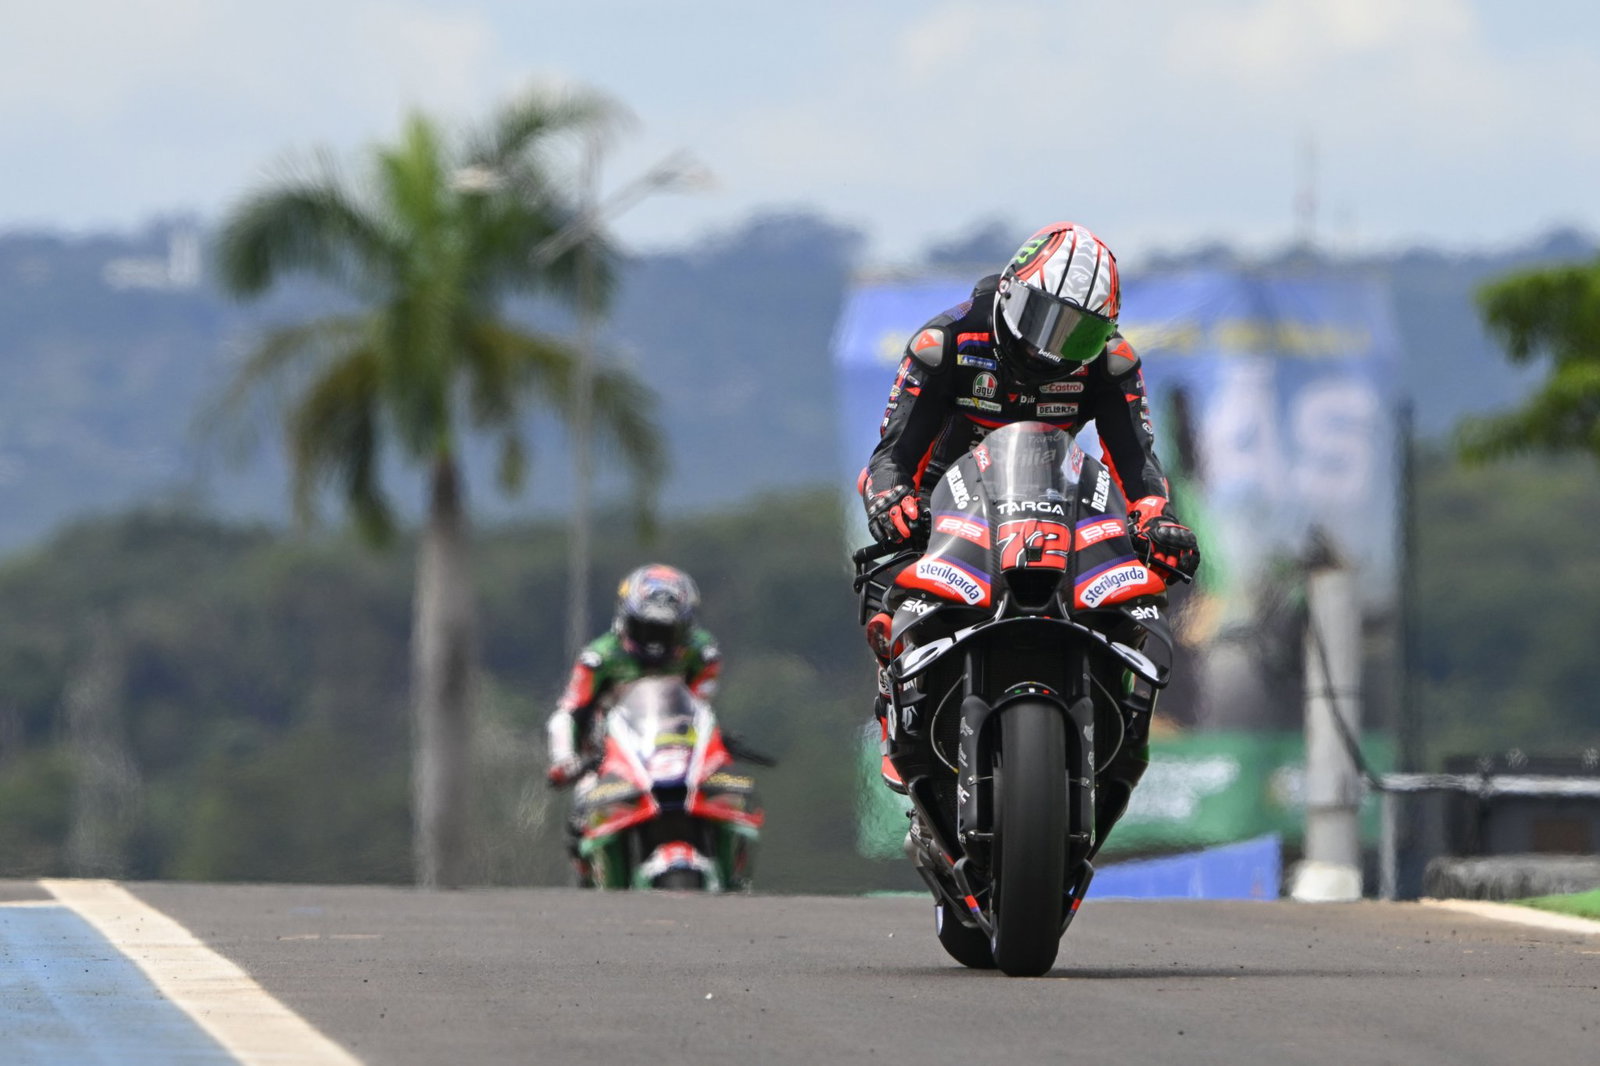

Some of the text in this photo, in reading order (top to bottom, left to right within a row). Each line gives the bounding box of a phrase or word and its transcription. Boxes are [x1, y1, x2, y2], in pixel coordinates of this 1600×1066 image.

[1049, 383, 1082, 392] Castrol
[997, 501, 1065, 516] TARGA
[939, 518, 984, 538] BS
[1080, 522, 1122, 541] BS
[996, 518, 1072, 574] 72
[919, 562, 980, 600] sterilgarda
[1085, 567, 1144, 604] sterilgarda
[902, 599, 936, 616] sky
[1131, 605, 1159, 620] sky
